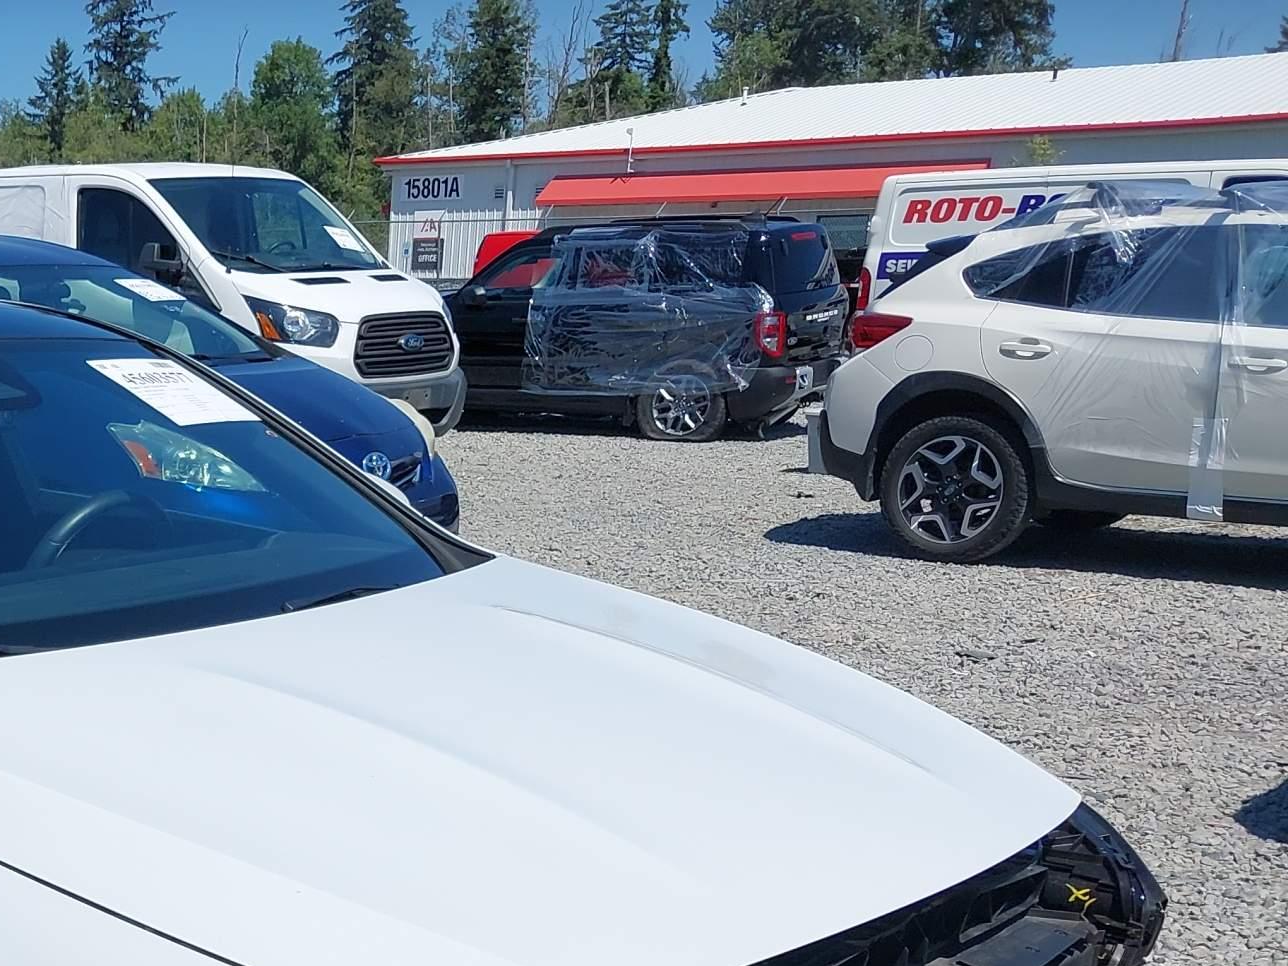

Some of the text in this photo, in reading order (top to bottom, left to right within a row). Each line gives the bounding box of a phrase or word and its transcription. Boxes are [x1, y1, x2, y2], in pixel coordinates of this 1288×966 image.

[405, 176, 460, 199] 15801A
[902, 193, 1068, 224] ROTO-R
[121, 372, 194, 385] 45603577
